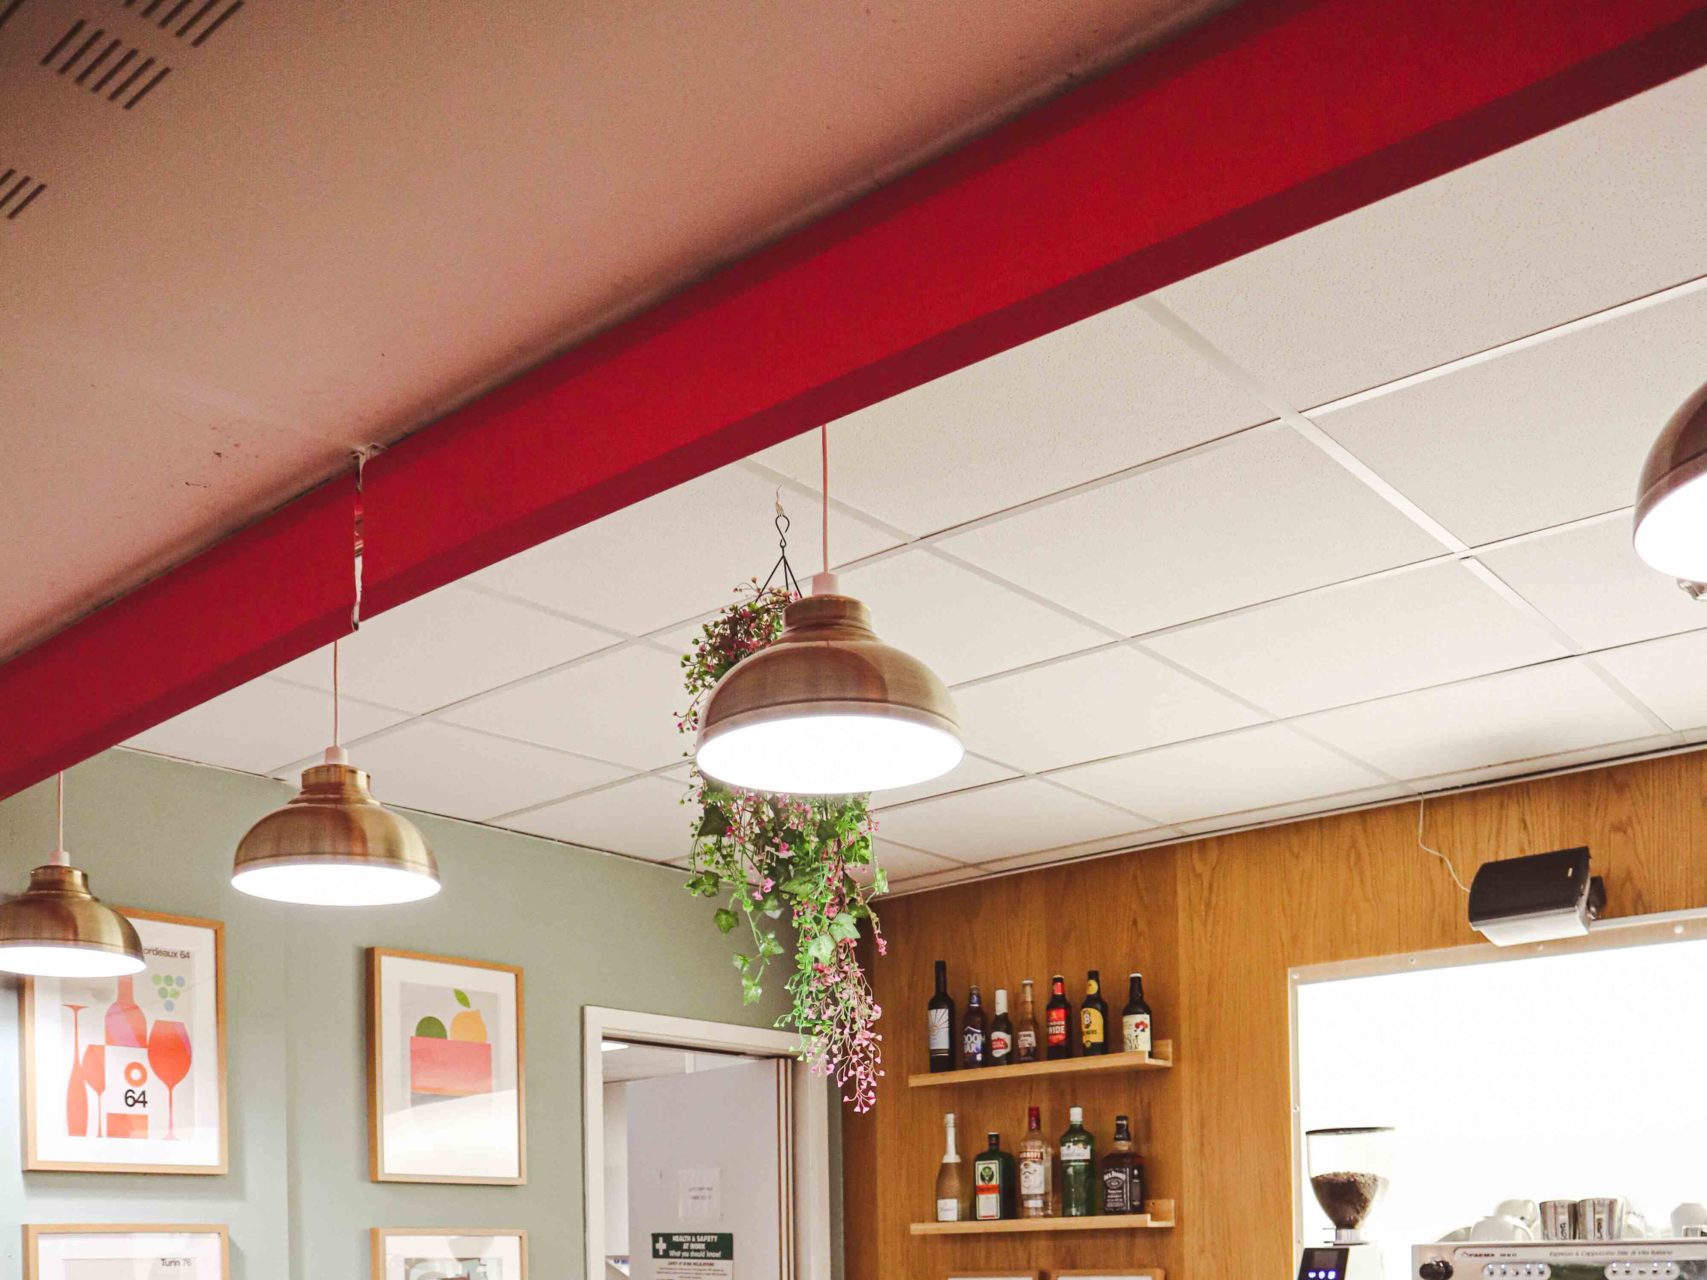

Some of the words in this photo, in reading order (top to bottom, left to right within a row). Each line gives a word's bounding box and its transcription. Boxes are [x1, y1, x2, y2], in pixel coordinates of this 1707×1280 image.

[144, 947, 178, 958] ordeaux
[180, 951, 190, 959] 64
[124, 1089, 148, 1108] 64
[160, 1257, 180, 1267] Turin
